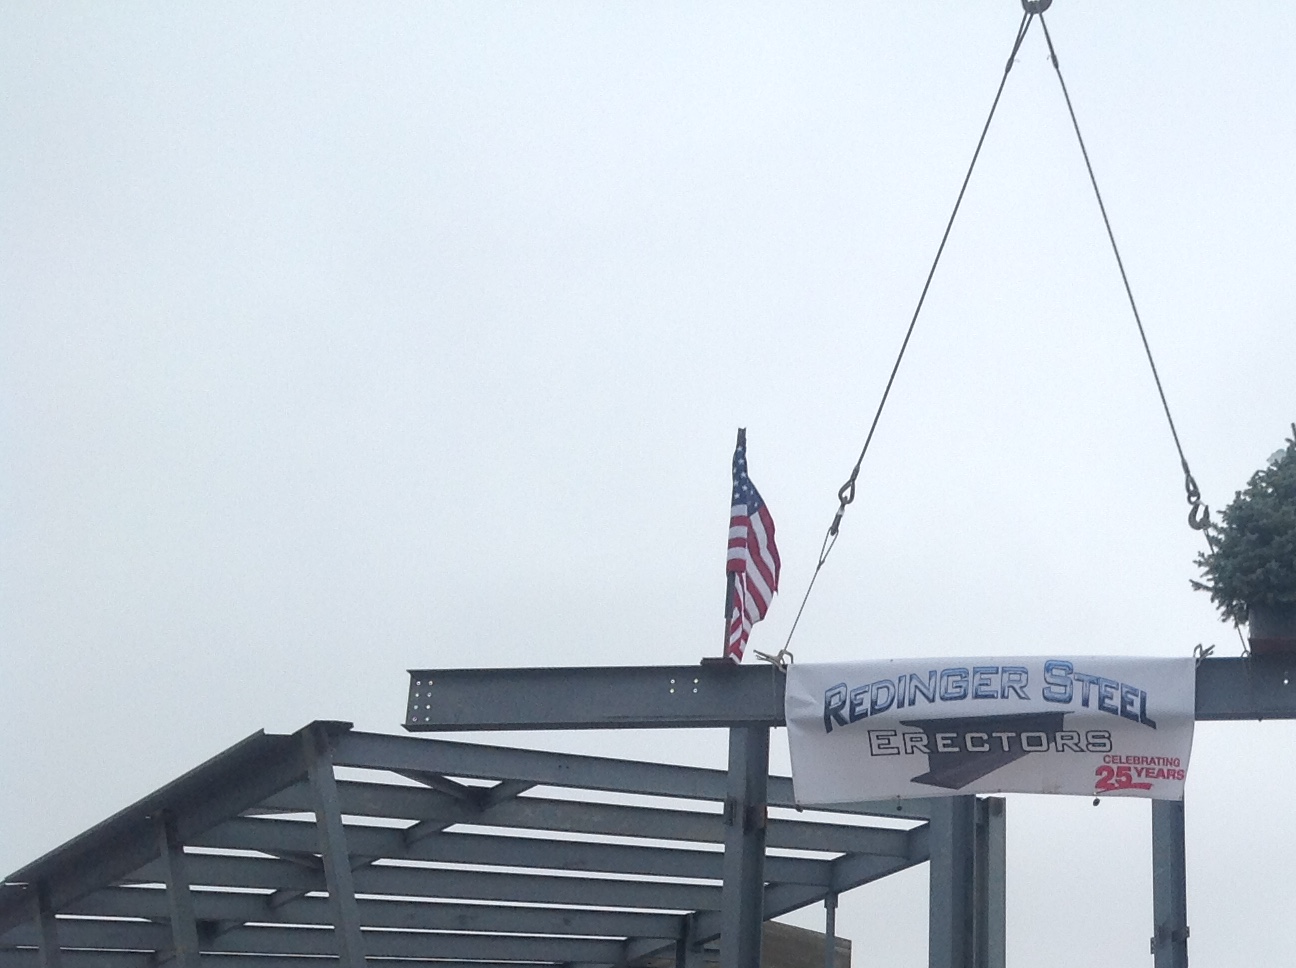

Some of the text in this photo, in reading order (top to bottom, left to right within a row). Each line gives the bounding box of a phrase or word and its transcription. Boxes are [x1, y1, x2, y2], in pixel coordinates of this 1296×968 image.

[824, 659, 1158, 734] REDINGER STEEL
[867, 729, 1113, 757] ERECTORS
[1103, 754, 1180, 767] CELEBRATING
[1095, 765, 1185, 790] 25 YEARS
